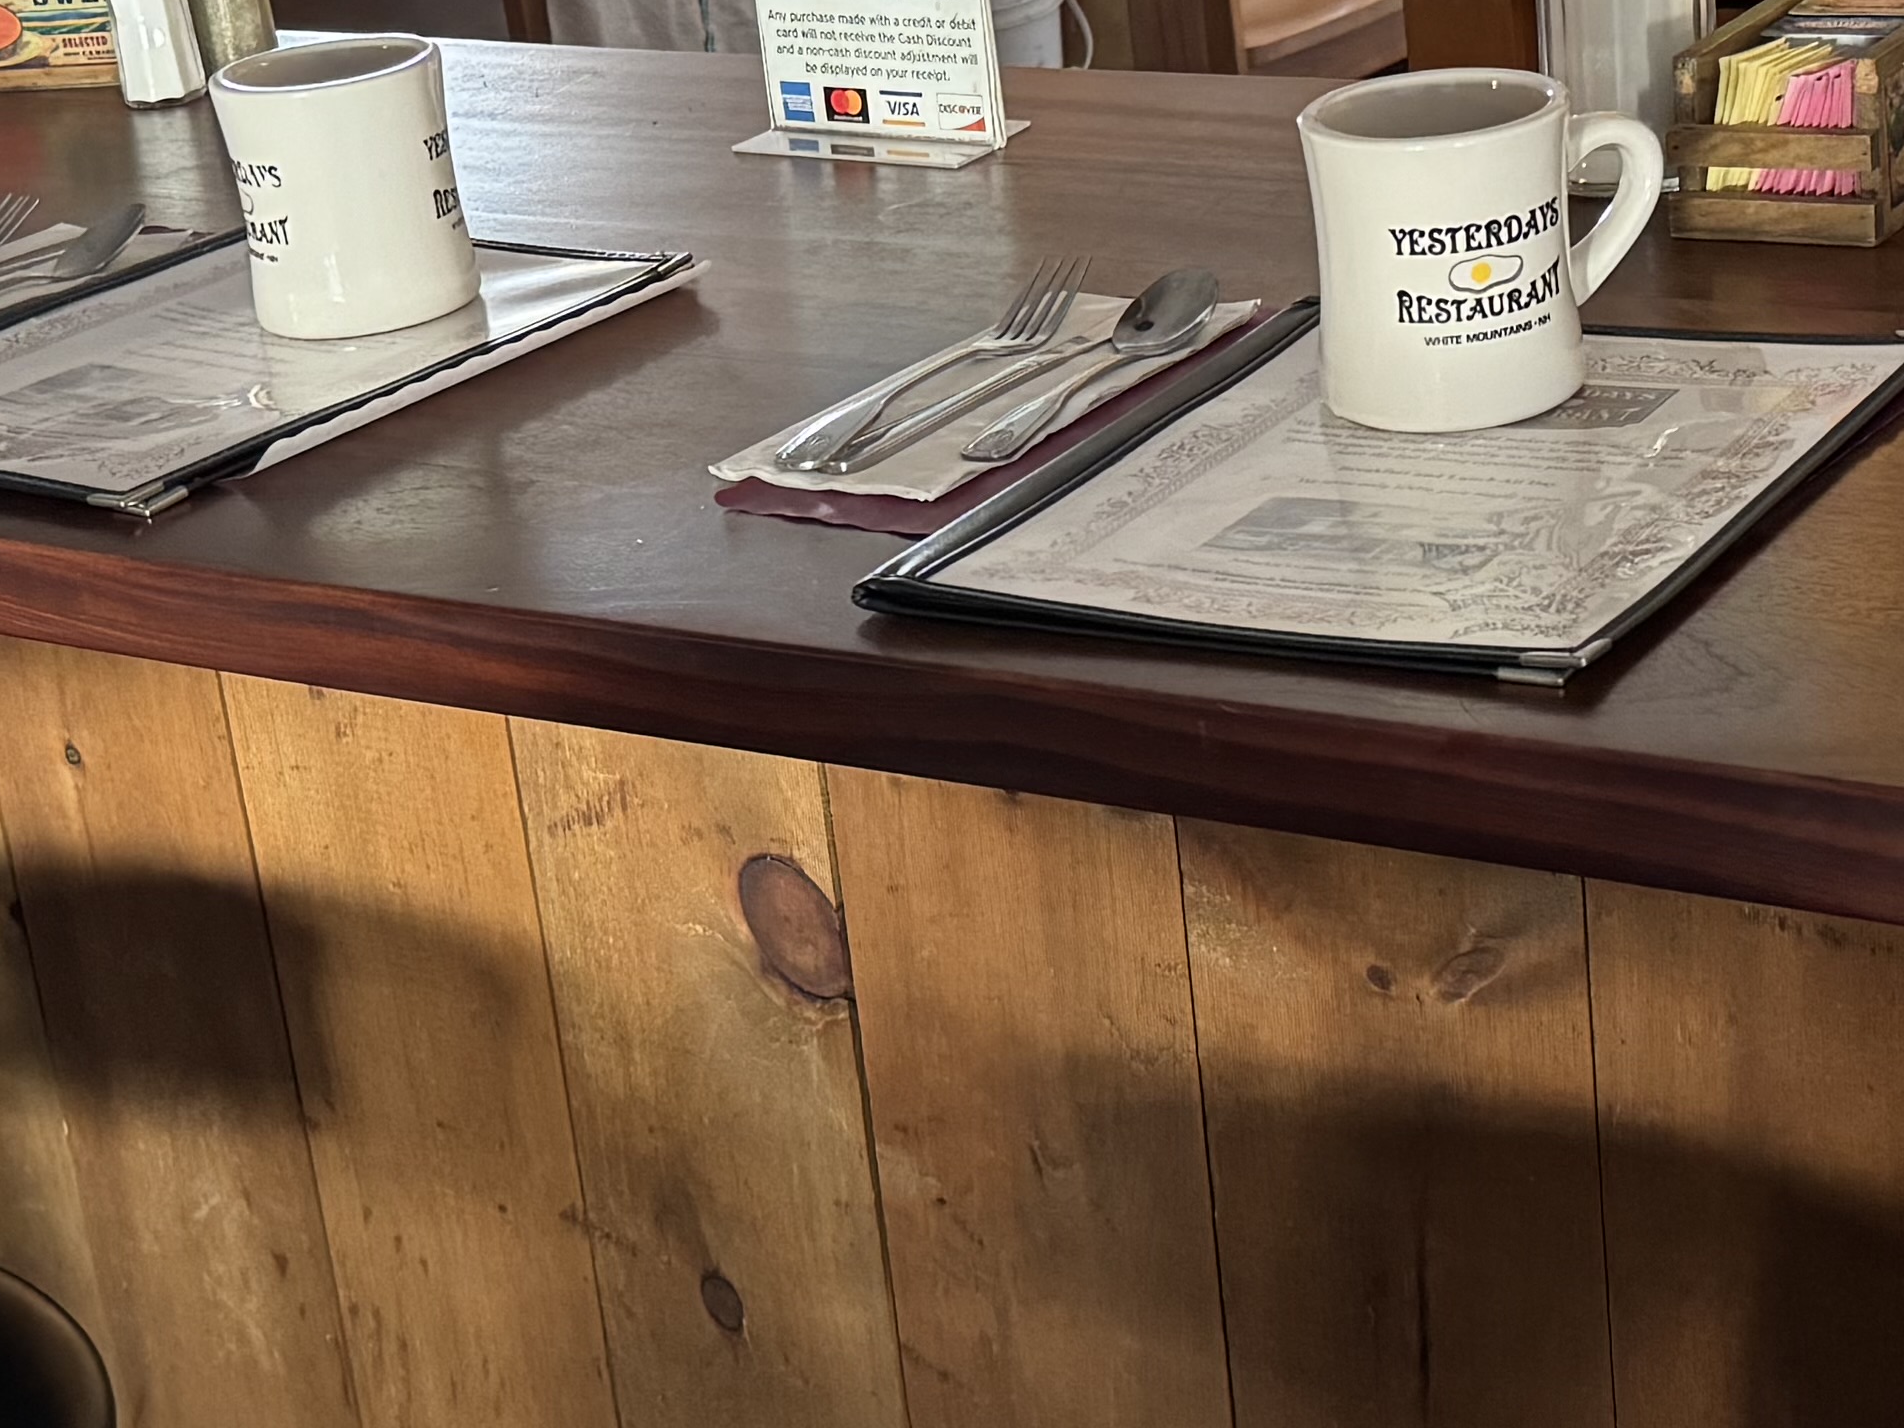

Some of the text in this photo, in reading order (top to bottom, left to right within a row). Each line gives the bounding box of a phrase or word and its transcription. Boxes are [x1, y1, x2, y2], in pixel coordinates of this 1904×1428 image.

[768, 9, 976, 31] Any purchase made with a credit or debit
[62, 35, 108, 49] SELECTED
[776, 28, 972, 48] card will not receive the Cash Discount
[777, 44, 978, 65] and a non-cash discount adjustment will
[805, 61, 817, 73] be
[820, 62, 868, 78] displayed
[870, 67, 883, 77] on
[885, 68, 908, 80] your
[886, 100, 920, 117] VISA
[1388, 196, 1559, 256] YESTERDAYS
[1396, 254, 1561, 324] RESTAURANT
[1424, 334, 1462, 346] WHITE
[1466, 319, 1533, 344] MOUNTAINS
